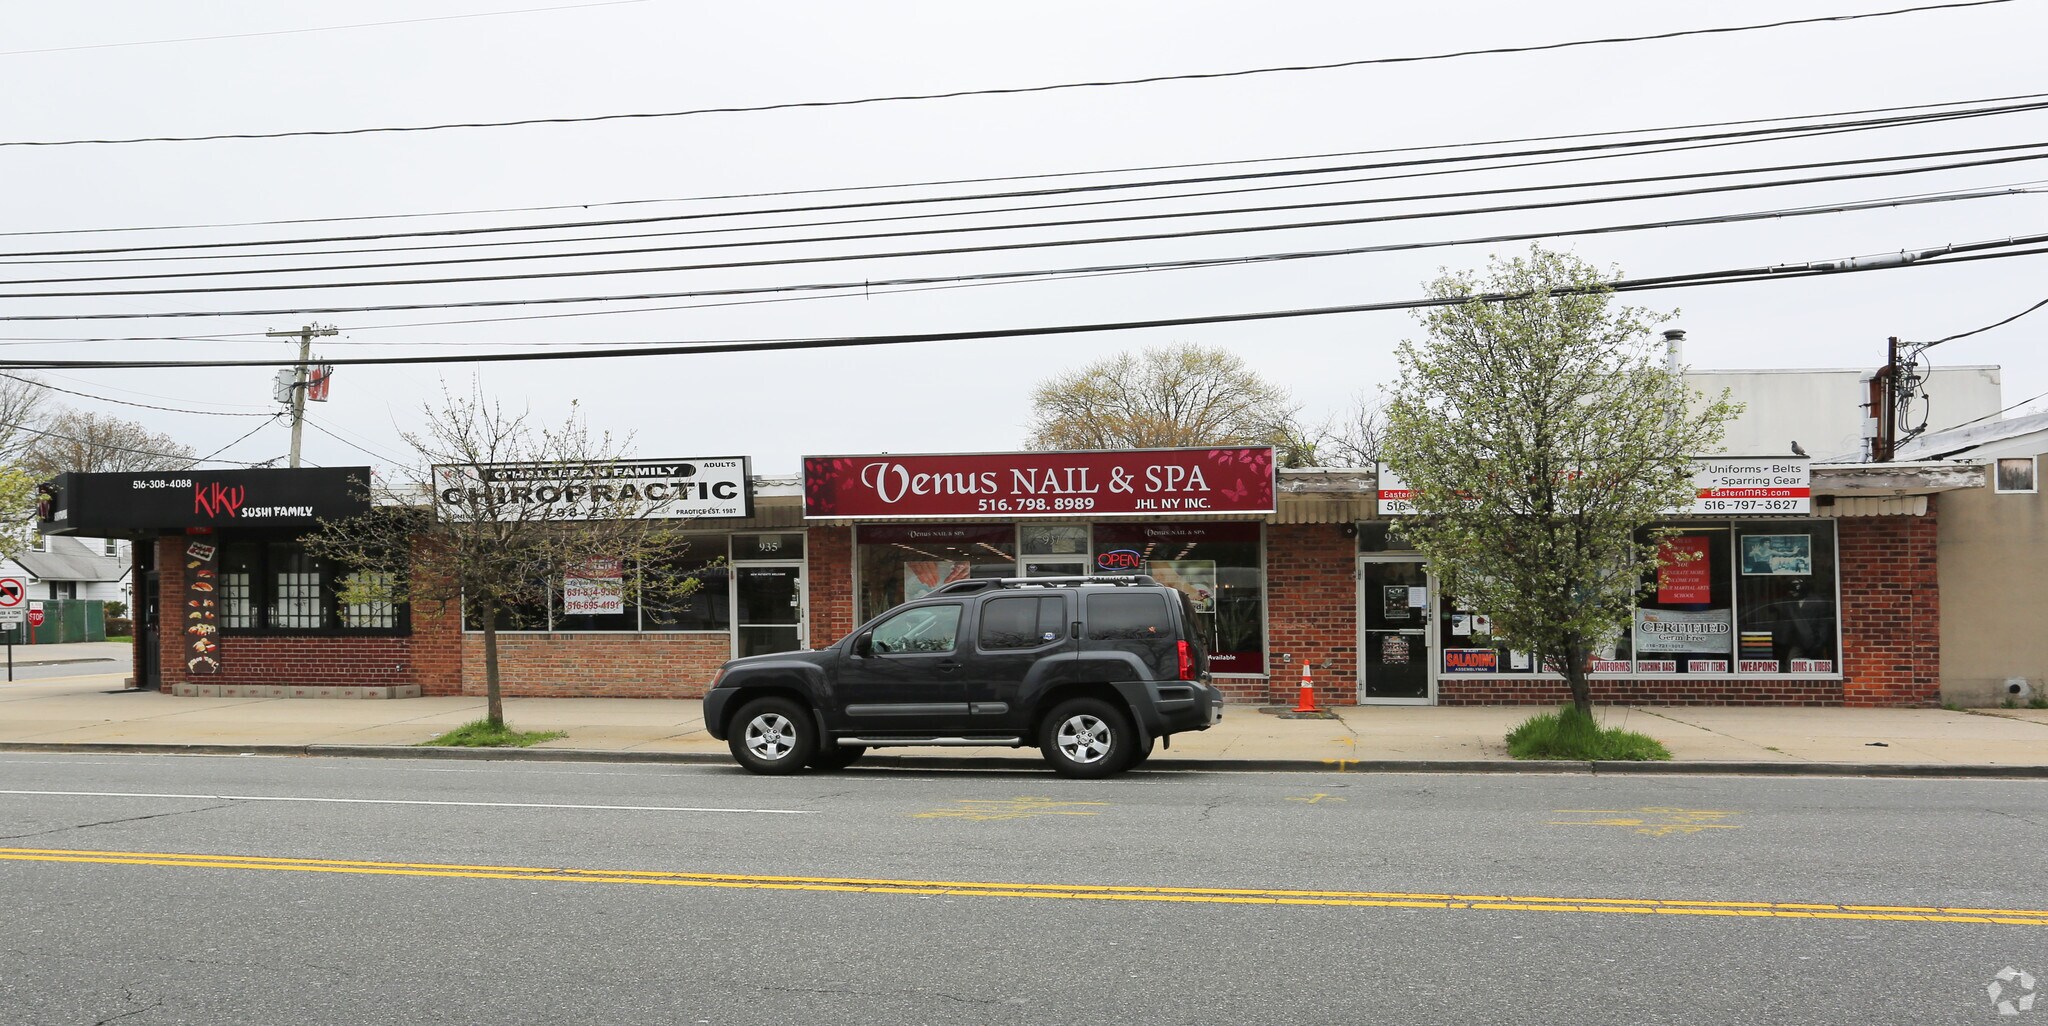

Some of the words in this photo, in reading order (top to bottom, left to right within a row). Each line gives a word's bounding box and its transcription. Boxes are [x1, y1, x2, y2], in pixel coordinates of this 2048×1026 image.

[614, 466, 679, 478] FAMILY
[1709, 465, 1762, 474] Uniforms
[1772, 464, 1802, 473] Belts
[132, 480, 192, 490] 516-308-4088
[861, 462, 1000, 503] Venus
[1010, 467, 1100, 495] NAIL
[1108, 466, 1134, 494] &
[1145, 465, 1211, 492] SPA
[1721, 476, 1770, 486] Sparring
[1773, 476, 1802, 485] Gear
[442, 481, 738, 505] CHIROPRACTIC
[1711, 488, 1791, 497] EasternMAS.com
[194, 482, 245, 518] KIKU
[1135, 499, 1158, 510] JHL
[1161, 499, 1180, 508] NY
[1184, 498, 1211, 508] INC.
[1704, 500, 1798, 510] 516-797-3627
[241, 506, 272, 518] SUSHI
[273, 506, 314, 518] FAMILY
[908, 530, 931, 538] Venus
[1144, 529, 1170, 537] Venus
[758, 542, 778, 552] 935
[1098, 553, 1140, 568] OPEN
[30, 613, 44, 621] STOP
[1640, 621, 1730, 634] CERTIFIED
[1446, 653, 1496, 667] SALADINO
[1595, 661, 1630, 672] UNIFORMS
[1690, 661, 1710, 672] NOVELTY
[1711, 661, 1726, 672] ITEMS
[1740, 661, 1778, 672] WEAPONS
[1814, 661, 1831, 672] VIDEOS
